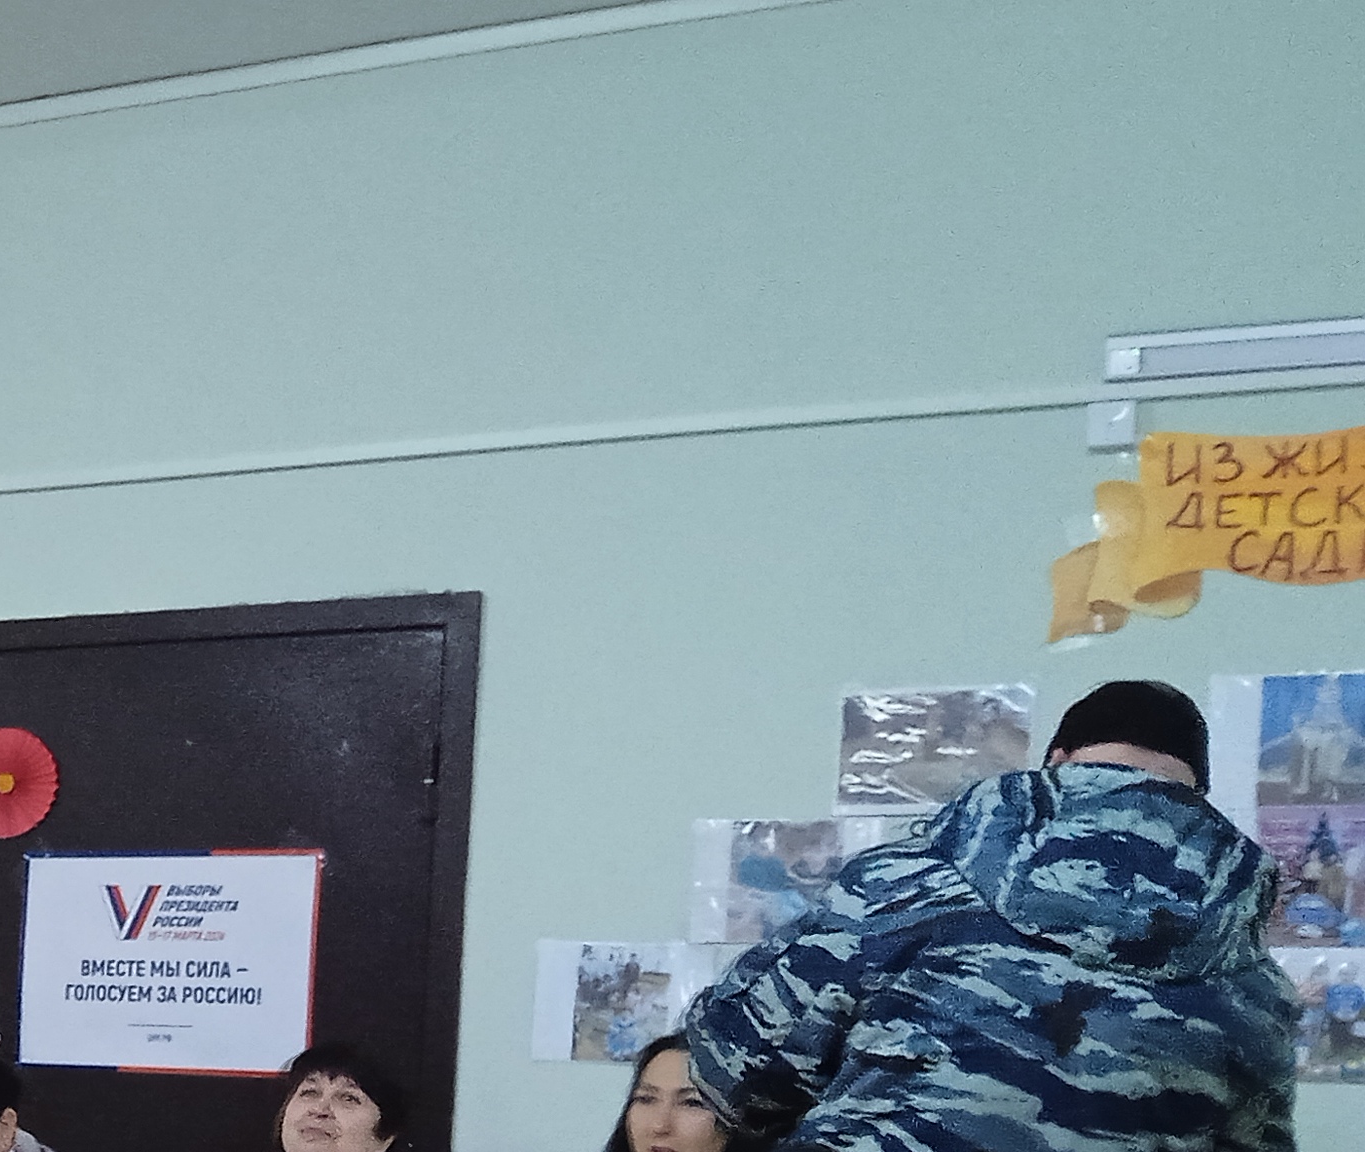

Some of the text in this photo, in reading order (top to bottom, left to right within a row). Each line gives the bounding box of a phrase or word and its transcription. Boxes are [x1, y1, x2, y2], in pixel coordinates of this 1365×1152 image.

[1165, 435, 1365, 486] ИЗ ЖИ
[1165, 484, 1365, 530] ДЕТСК
[1227, 530, 1365, 581] САД
[166, 885, 223, 897] ВЫБОРЫ
[158, 900, 239, 913] ПРЕЗИДЕНТА
[152, 916, 204, 928] РОССИИ
[81, 959, 145, 977] ВМЕСТЕ
[150, 960, 180, 977] МЫ
[186, 961, 231, 978] СИЛА
[65, 984, 262, 1005] ГОЛОСУЕМ ЗА РОССИЮ!
